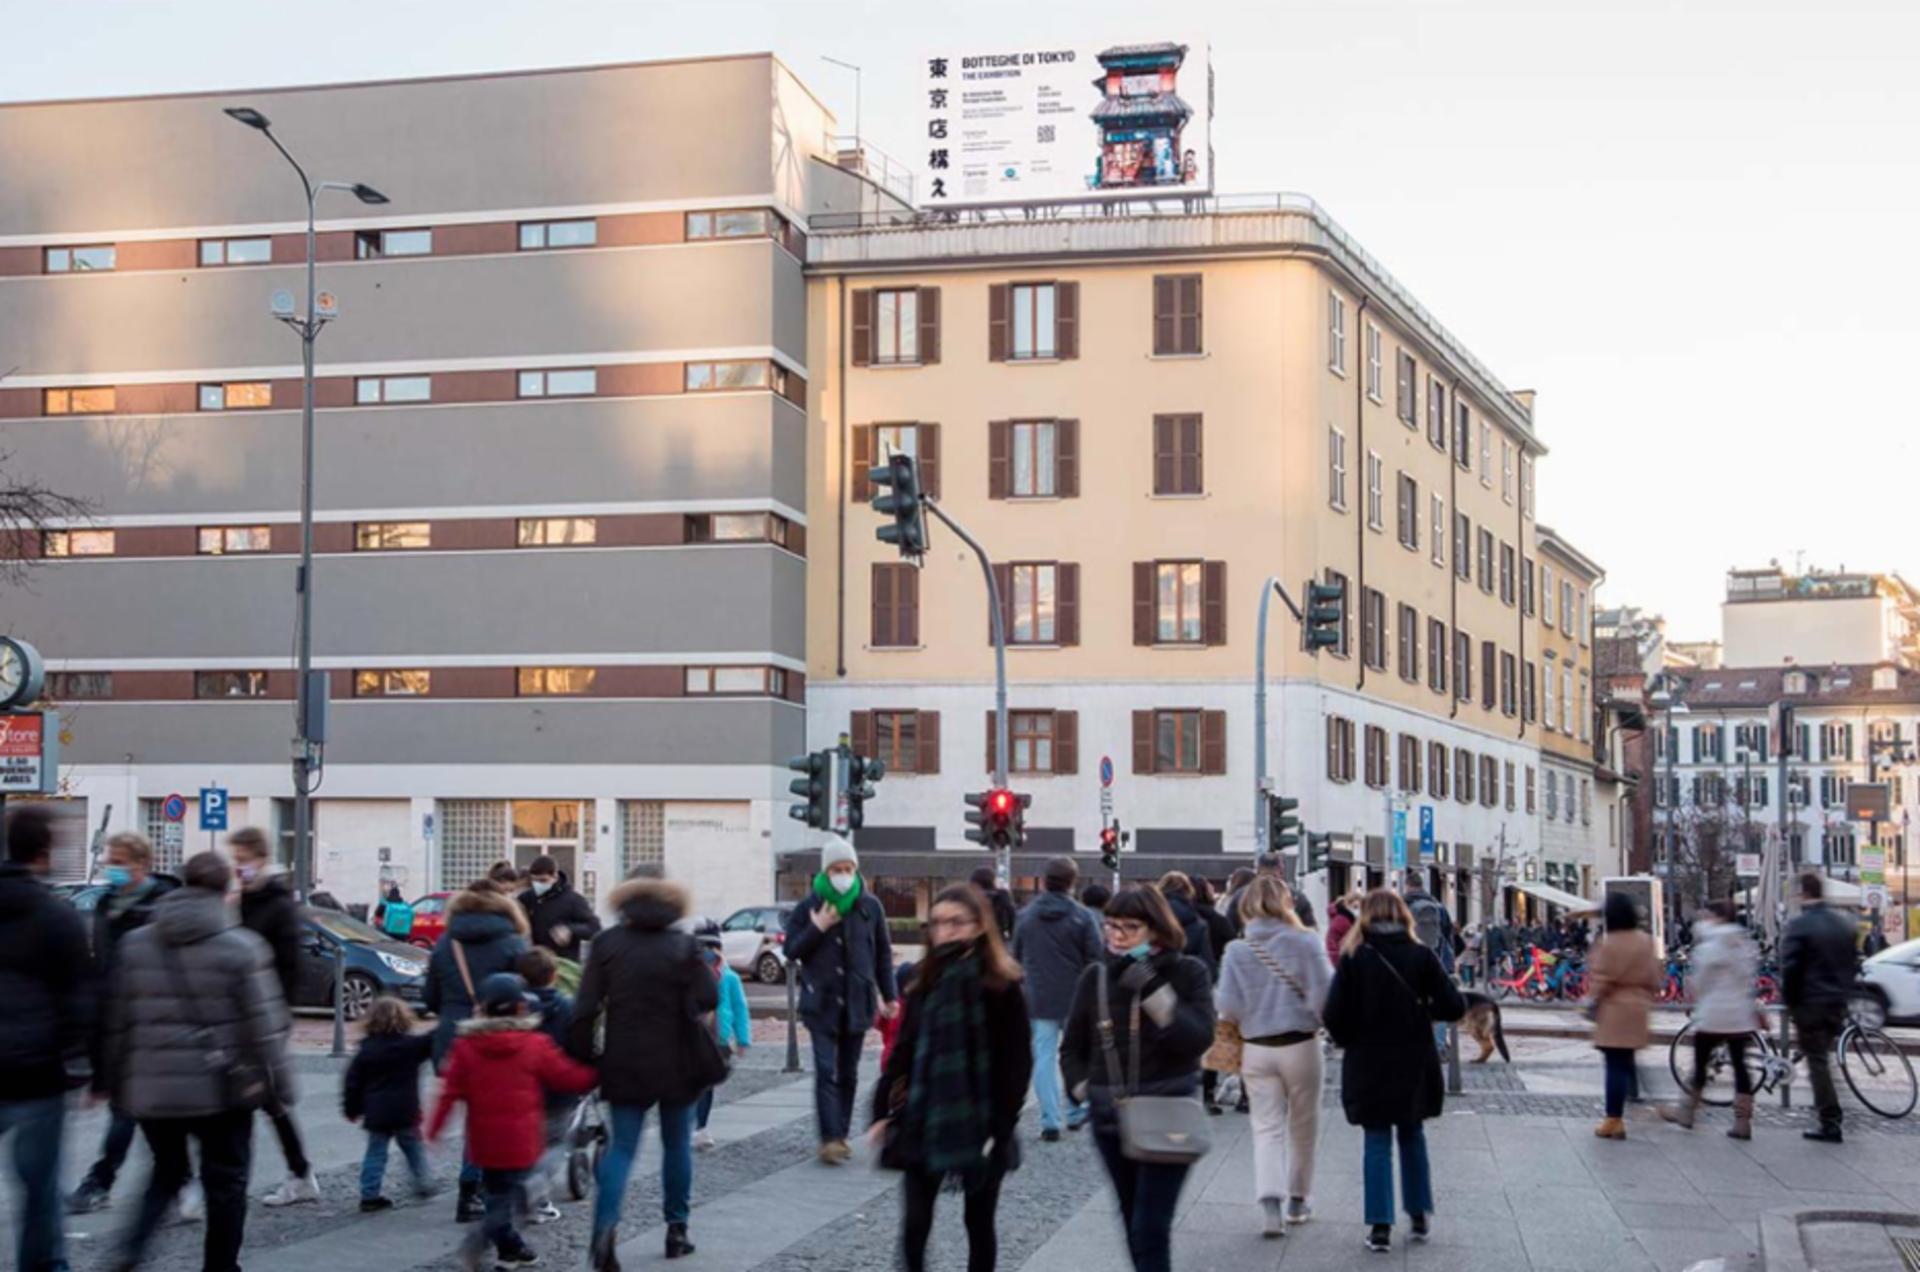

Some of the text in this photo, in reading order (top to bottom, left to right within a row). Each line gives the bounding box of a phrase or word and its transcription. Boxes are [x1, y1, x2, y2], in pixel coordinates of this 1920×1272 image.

[962, 50, 1076, 69] BOTTEGHE DI TOKYO
[962, 69, 1021, 81] THE EXHIBITION
[3, 775, 32, 784] AIRES
[205, 792, 222, 815] P
[1423, 809, 1431, 831] P
